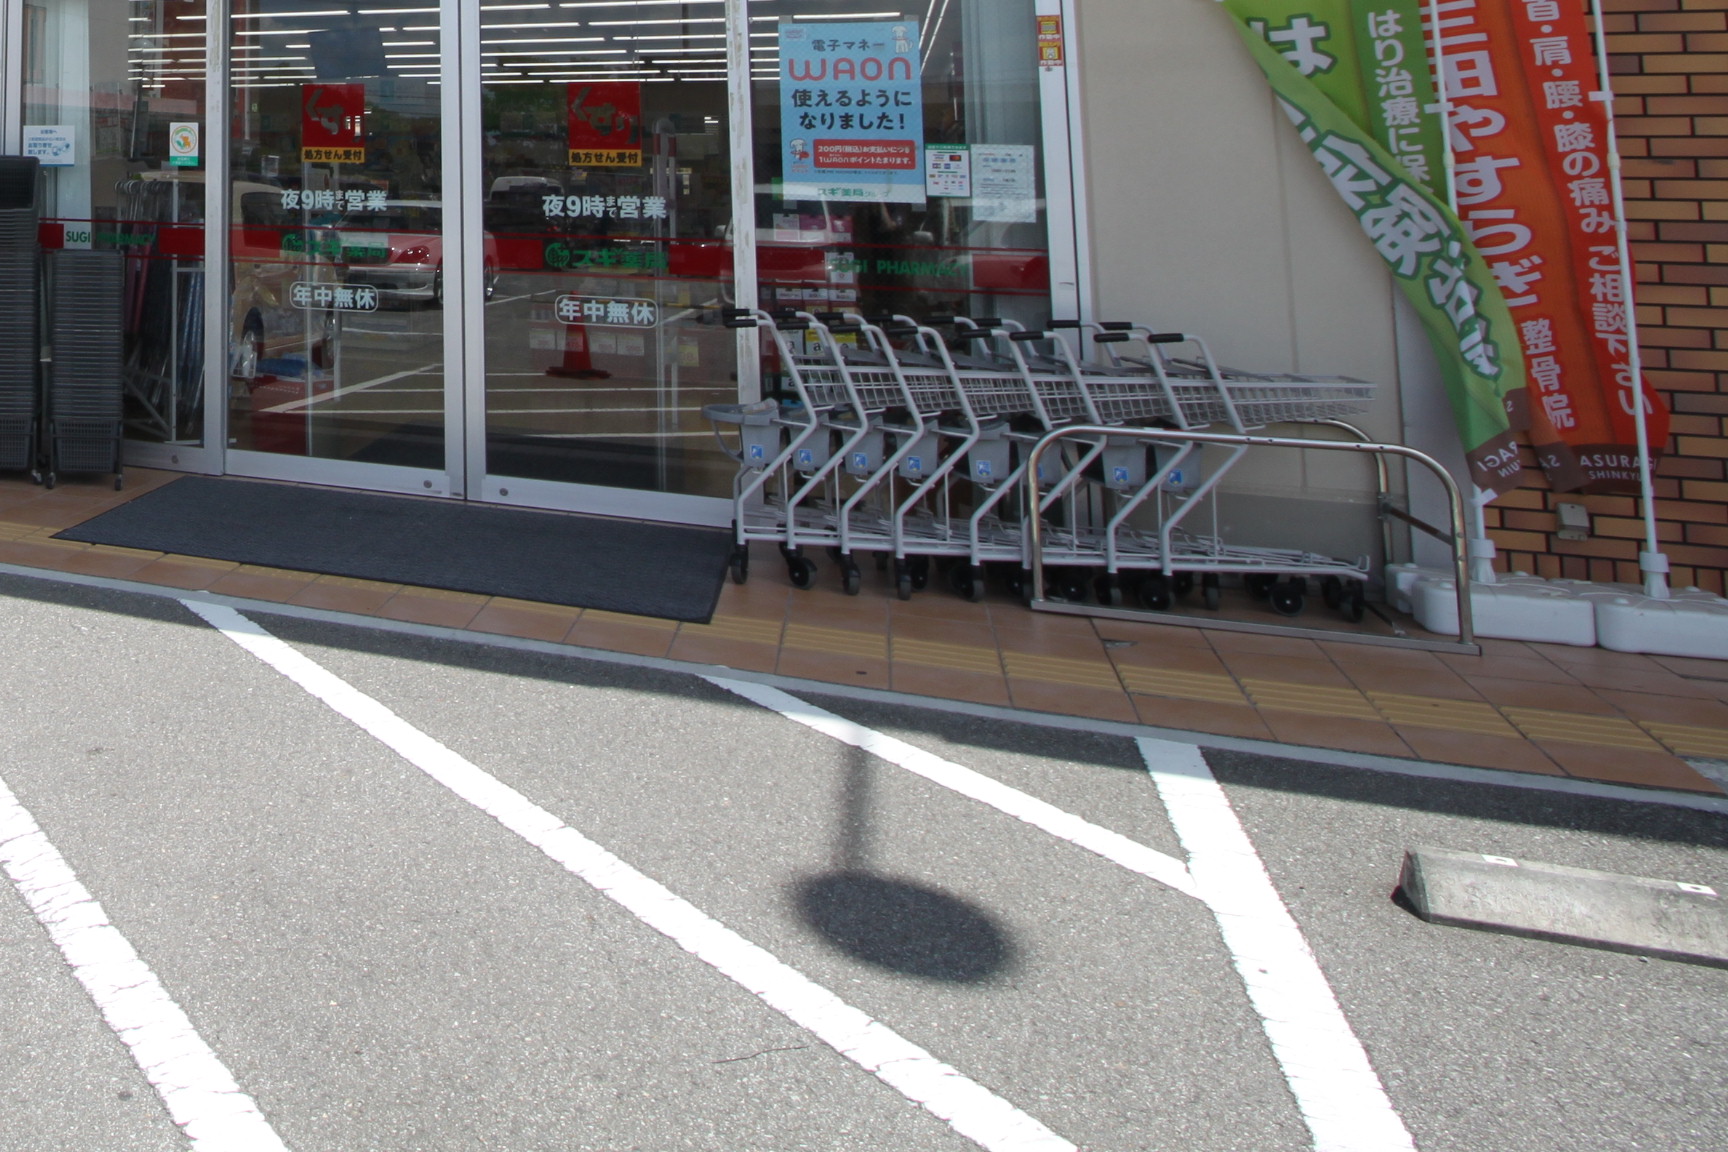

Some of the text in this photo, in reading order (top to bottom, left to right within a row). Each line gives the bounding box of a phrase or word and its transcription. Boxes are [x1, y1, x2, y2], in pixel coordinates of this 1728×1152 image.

[812, 39, 885, 52] 電子マネー
[788, 56, 912, 81] WAON
[791, 88, 912, 108] 使えるように
[1367, 9, 1434, 194] はり治療に保
[303, 149, 362, 161] 処方せん受付
[571, 151, 639, 164] 処方せん受付
[280, 189, 388, 212] 夜9時まで営業
[542, 195, 667, 219] 夜9時まで営業
[65, 230, 91, 243] SUGI
[877, 260, 970, 277] PHARMACY
[293, 285, 376, 310] 年中無休
[559, 299, 655, 325] 年中無休
[1521, 318, 1576, 429] 整骨院
